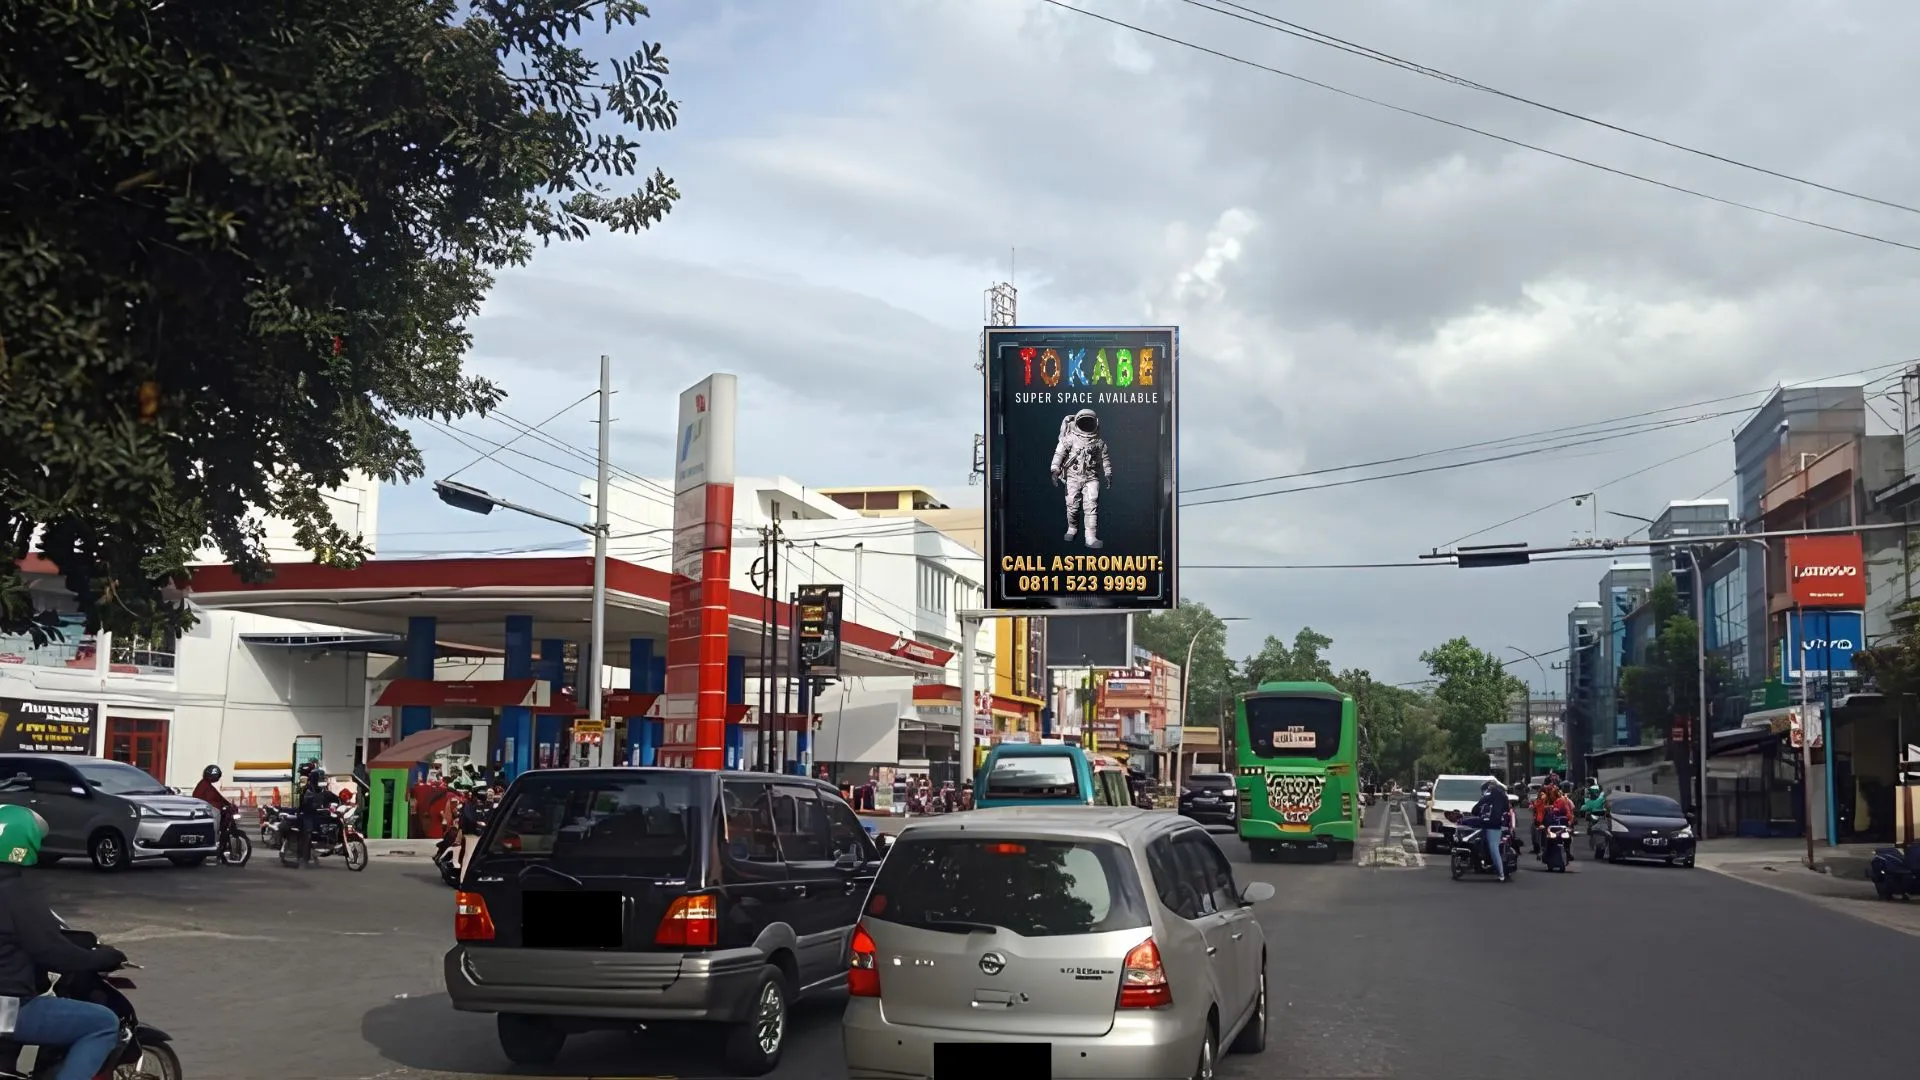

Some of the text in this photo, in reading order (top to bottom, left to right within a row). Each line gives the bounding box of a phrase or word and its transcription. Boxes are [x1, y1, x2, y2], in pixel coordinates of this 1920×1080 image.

[1019, 347, 1154, 388] TOKABE
[1015, 392, 1159, 404] SUPER SPACE AVAILABLE
[1002, 555, 1163, 572] CALL ASTRONAUT:
[1018, 575, 1147, 592] 0811 523 9999
